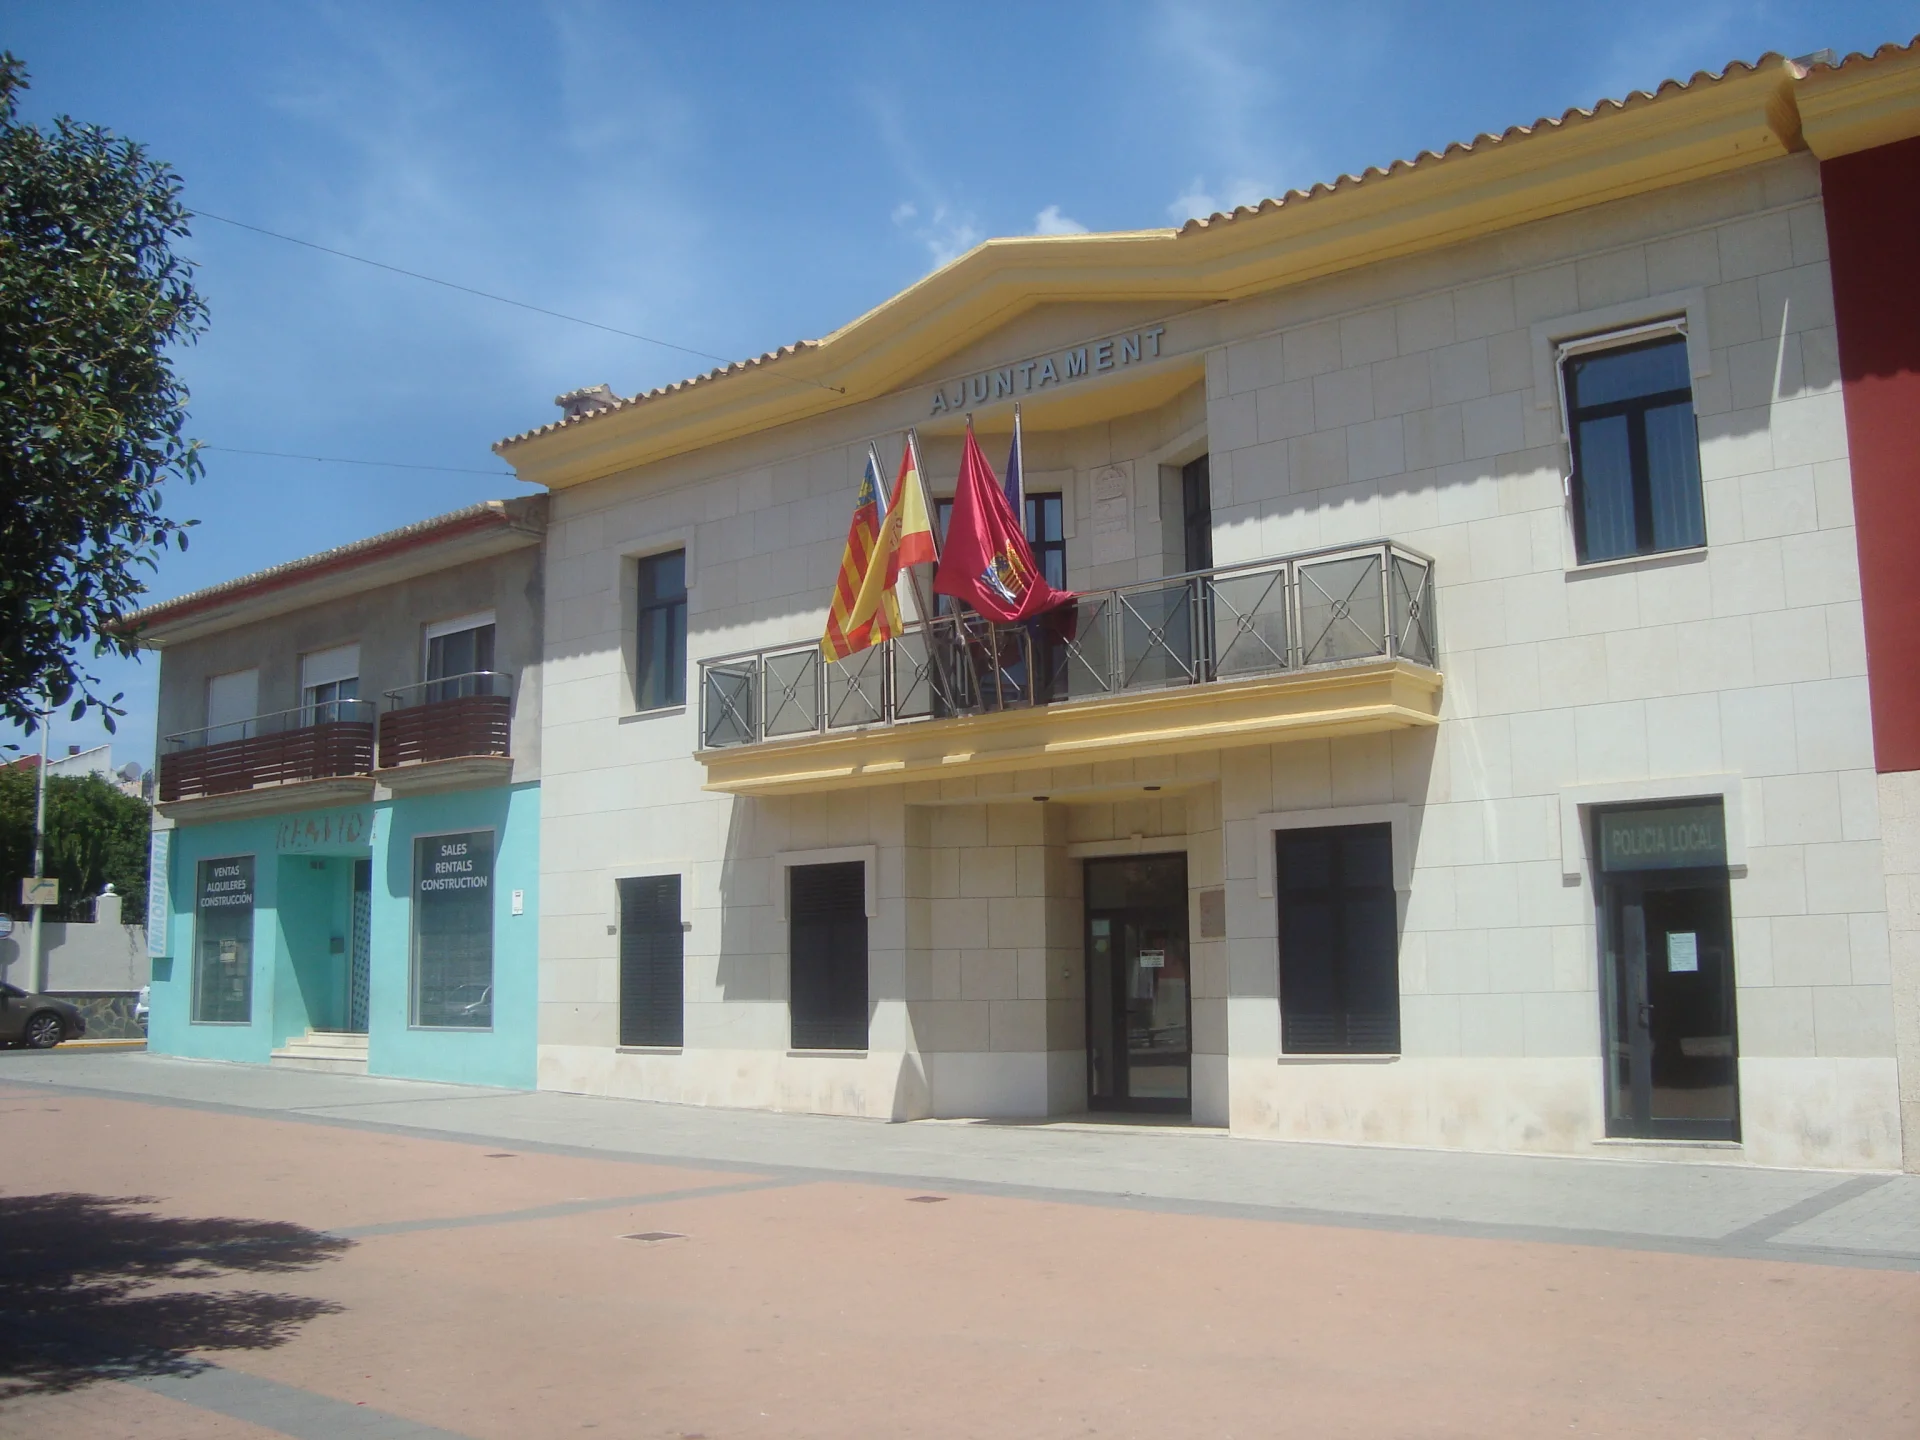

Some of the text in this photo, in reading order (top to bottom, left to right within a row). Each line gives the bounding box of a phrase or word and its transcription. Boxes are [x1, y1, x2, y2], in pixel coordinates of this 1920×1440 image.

[930, 327, 1165, 415] AJUNTAMENT
[1670, 824, 1716, 851] LOCAL
[441, 843, 467, 856] SALES
[214, 865, 240, 877] VENTAS
[435, 860, 473, 873] RENTALS
[206, 879, 246, 892] ALQUILERES
[421, 876, 488, 891] CONSTRUCTION
[150, 832, 168, 953] INMOBILIARIA
[200, 891, 252, 907] CONSTRUCCIÓN
